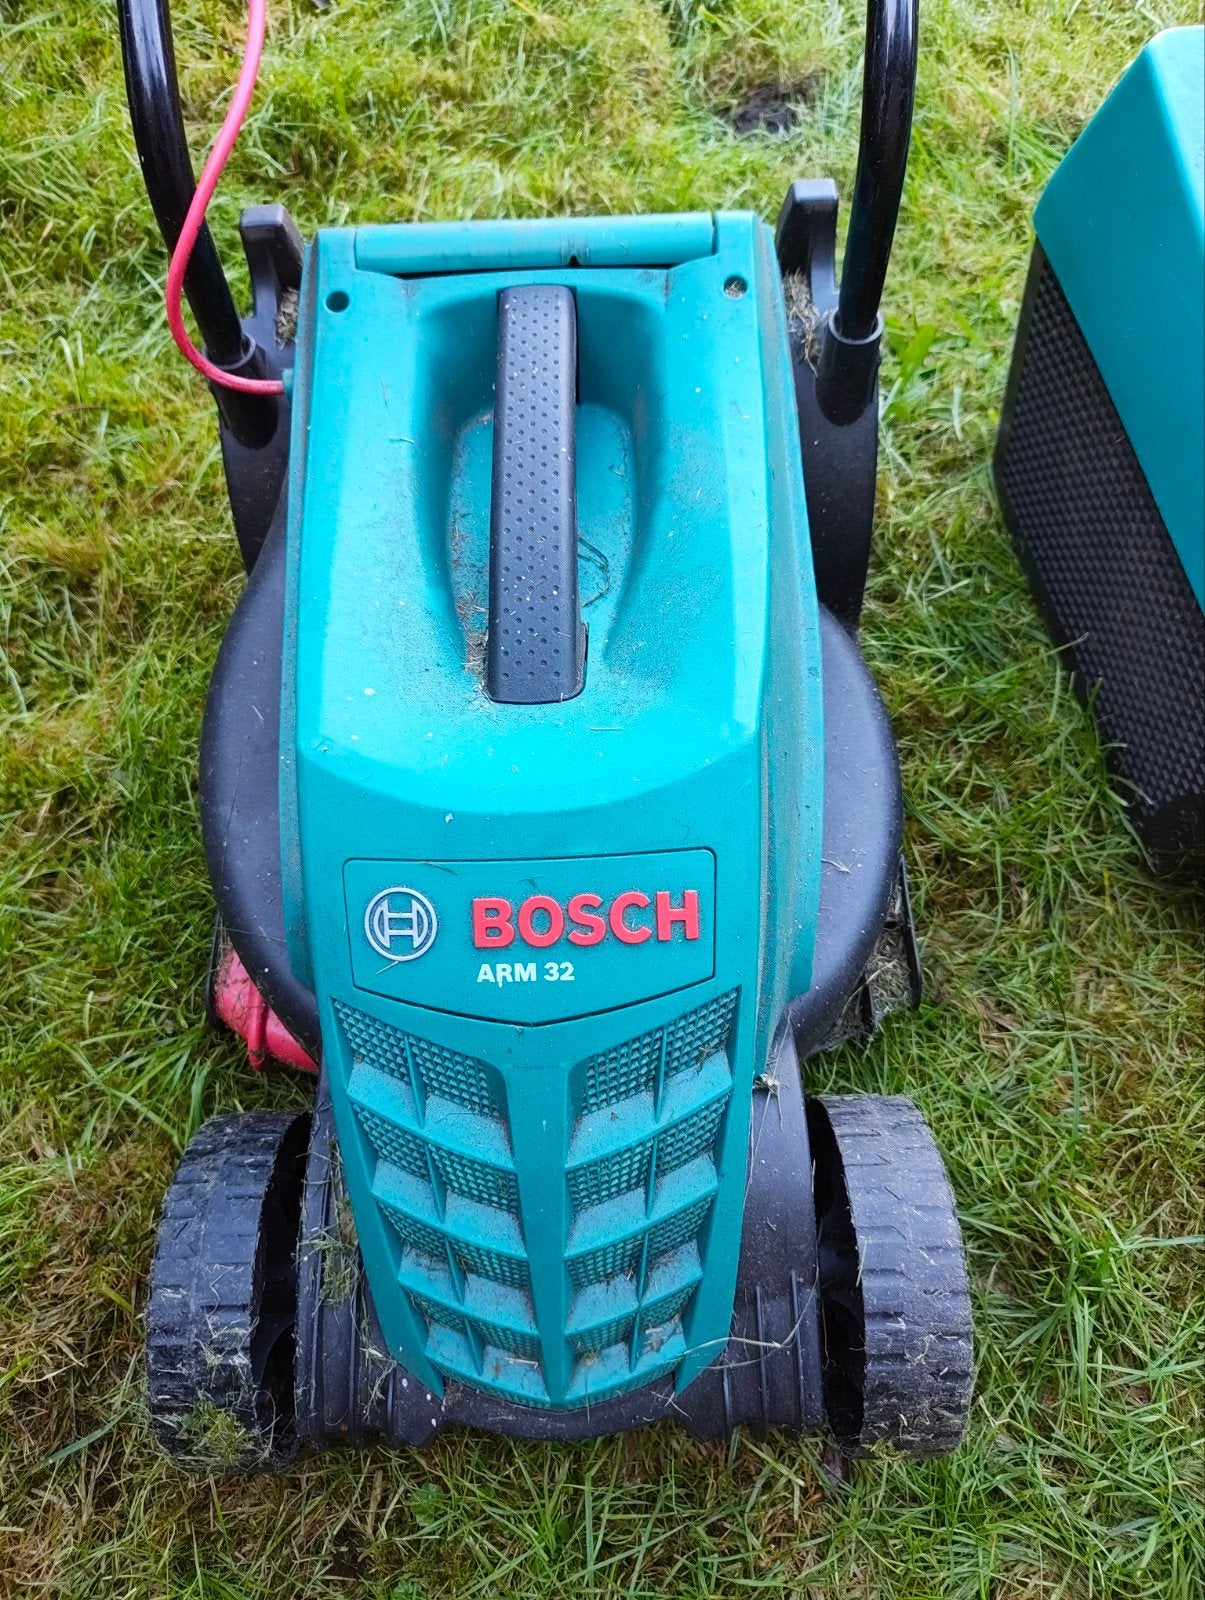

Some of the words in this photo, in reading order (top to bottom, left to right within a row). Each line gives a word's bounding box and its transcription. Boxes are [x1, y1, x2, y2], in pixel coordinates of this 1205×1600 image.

[472, 890, 699, 948] BOSCH
[477, 962, 537, 983] ARM
[543, 961, 576, 981] 32
